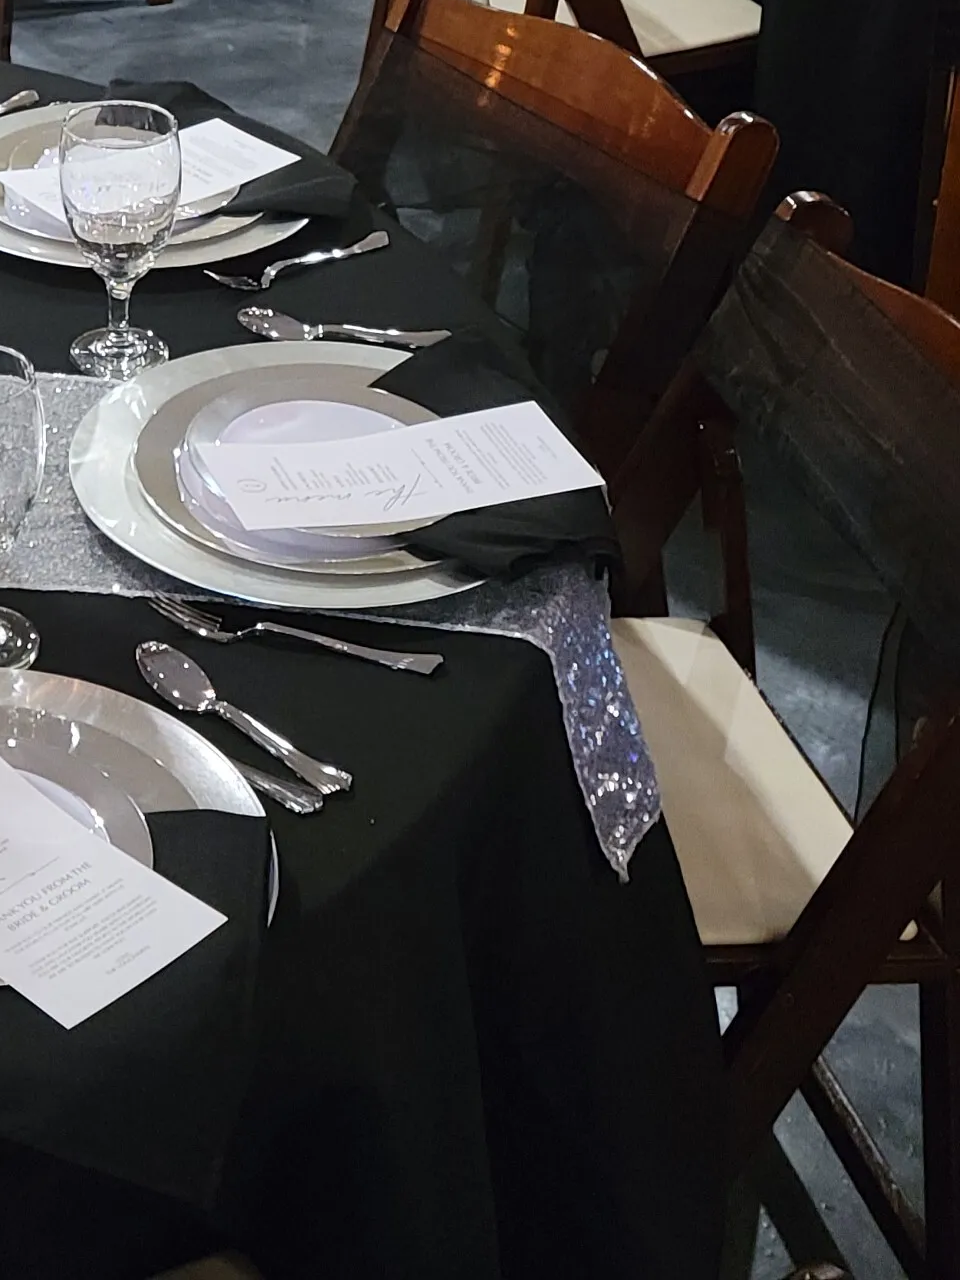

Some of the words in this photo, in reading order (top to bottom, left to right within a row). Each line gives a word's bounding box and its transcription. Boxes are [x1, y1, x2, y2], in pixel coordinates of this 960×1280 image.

[6, 909, 40, 932] BRIDE
[37, 903, 49, 912] &
[46, 877, 91, 907] GROOM
[14, 891, 43, 911] YOU
[40, 872, 74, 895] FROM
[68, 860, 92, 877] THE
